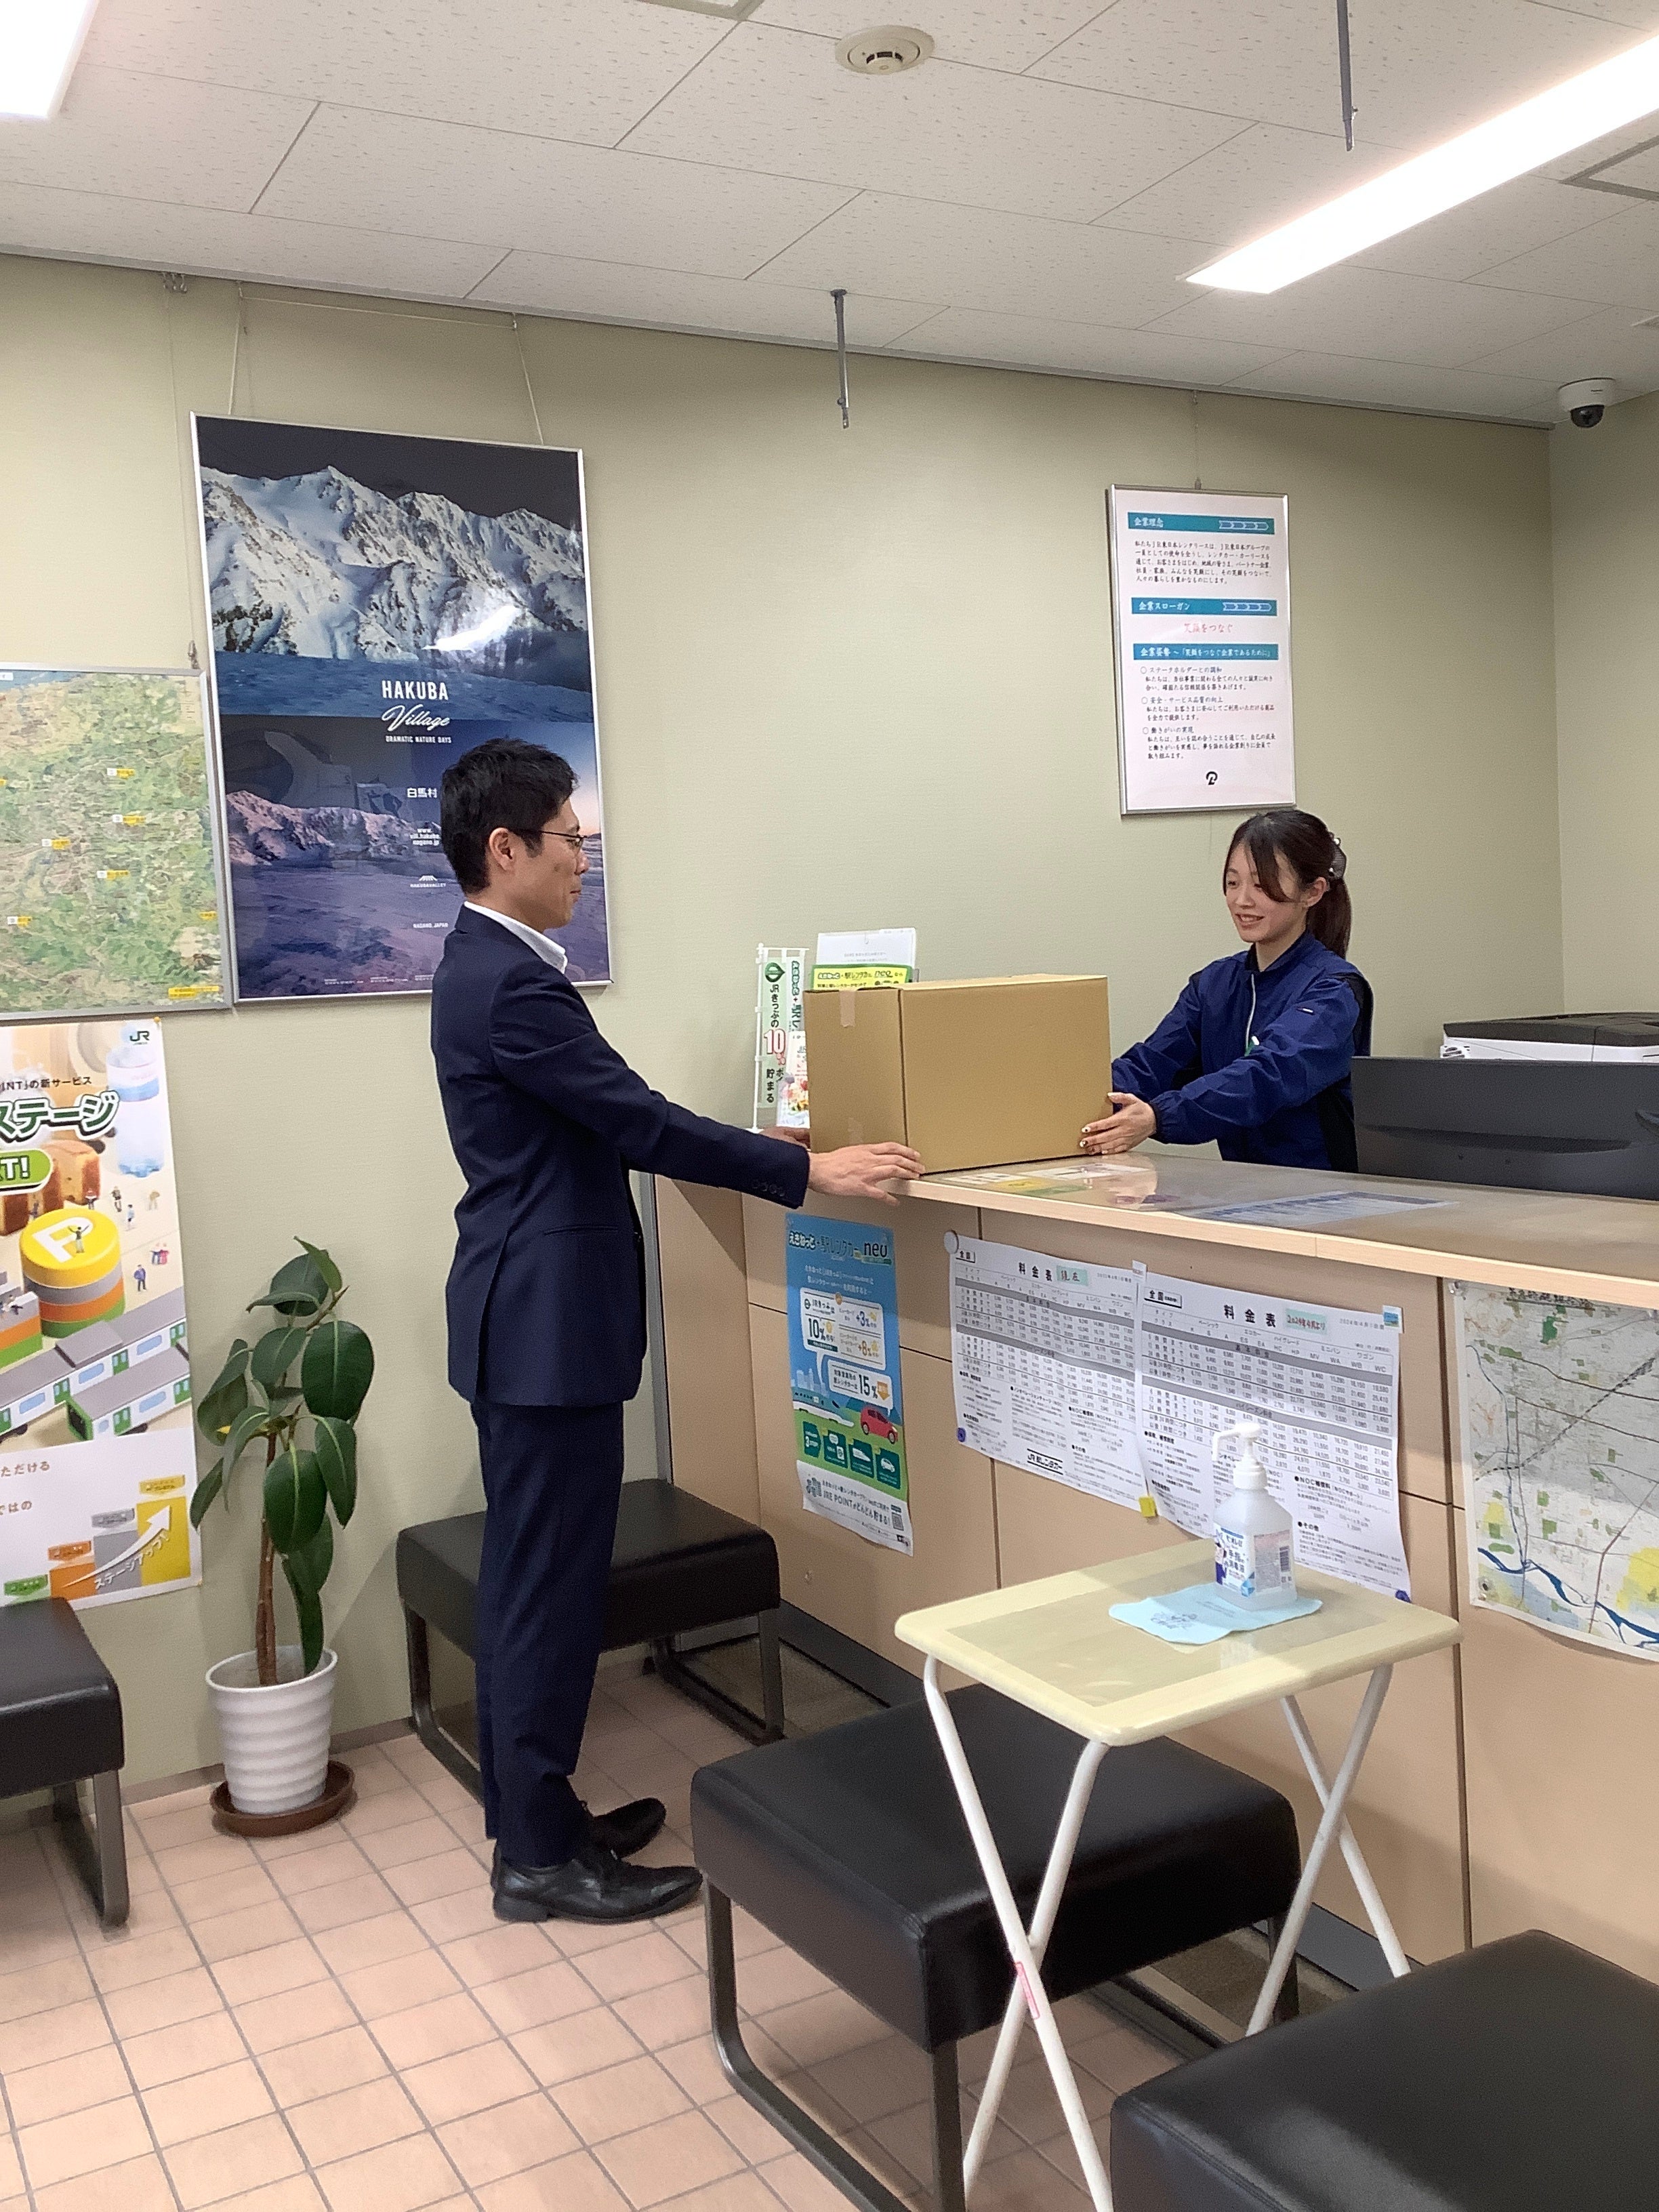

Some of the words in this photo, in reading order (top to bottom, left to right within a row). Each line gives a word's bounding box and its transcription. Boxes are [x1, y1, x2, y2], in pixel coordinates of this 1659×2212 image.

[1139, 602, 1190, 611] 企業スローガン
[382, 680, 449, 700] HAKUBA
[382, 704, 450, 731] Village
[407, 787, 437, 798] 白馬村
[129, 1031, 150, 1042] JR
[0, 1156, 29, 1186] T!
[1019, 1262, 1052, 1282] 料金表
[1223, 1305, 1276, 1328] 料金表
[859, 1374, 878, 1399] 15%
[1303, 1522, 1319, 1532] その他
